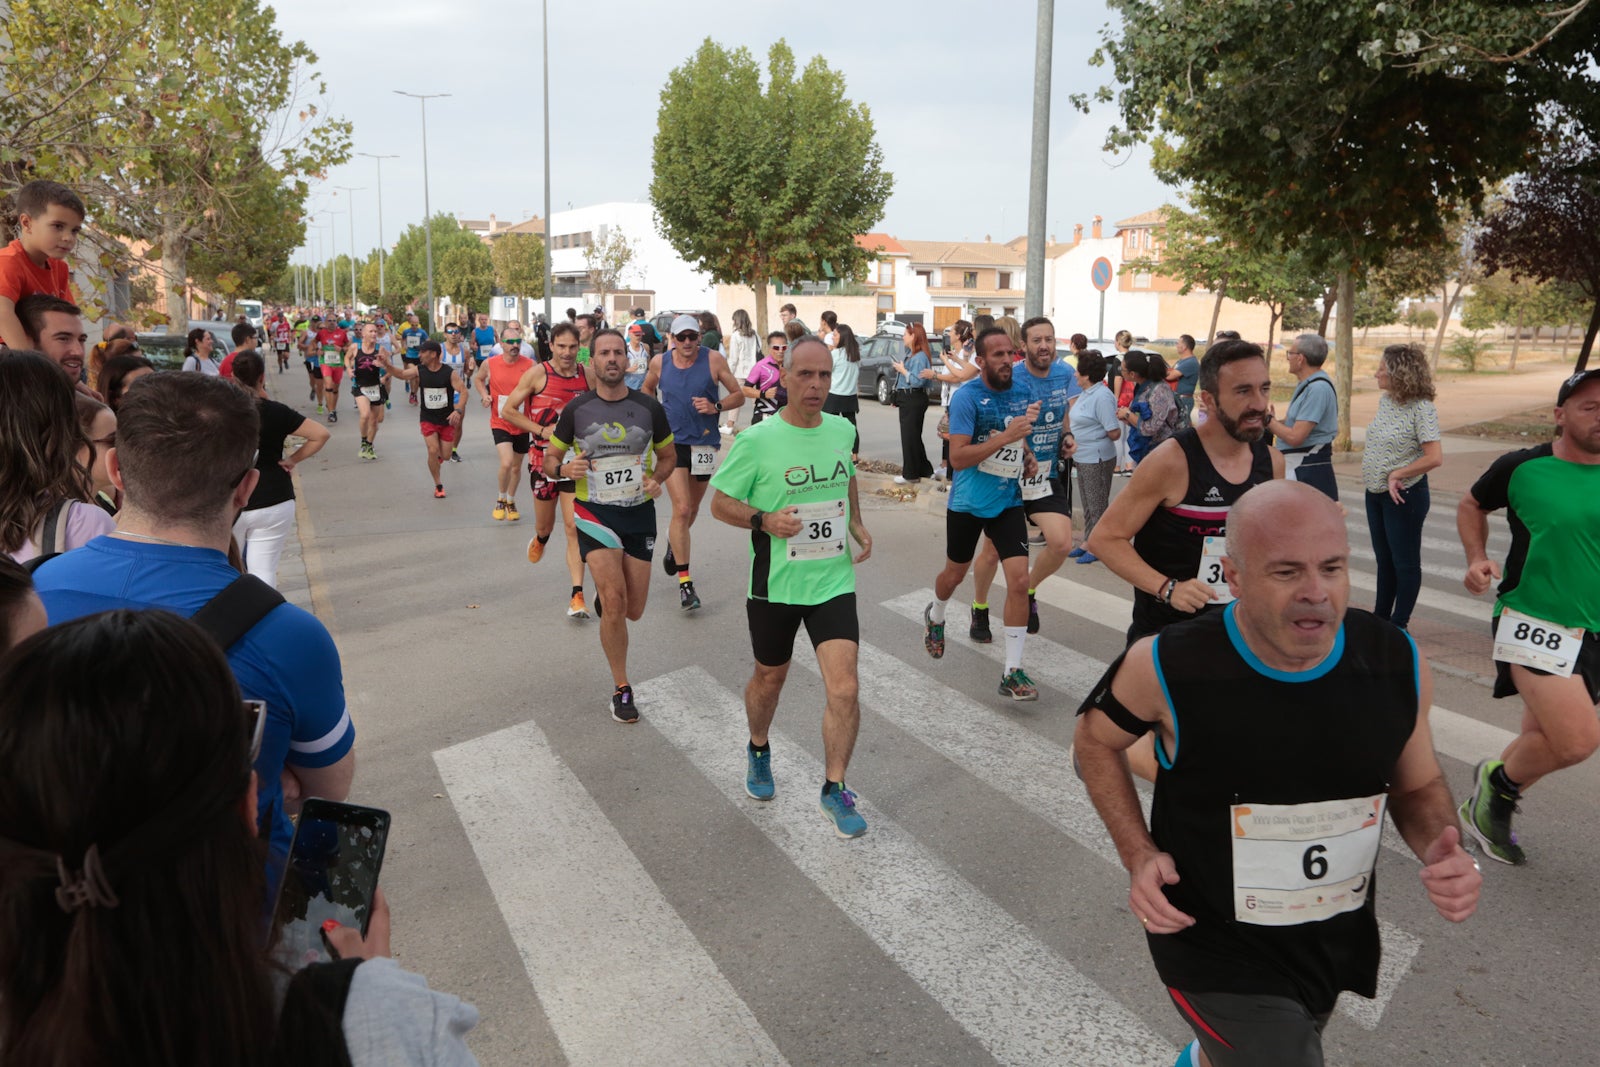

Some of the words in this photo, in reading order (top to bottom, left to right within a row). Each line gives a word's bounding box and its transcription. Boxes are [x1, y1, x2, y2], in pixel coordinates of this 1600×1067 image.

[506, 298, 514, 307] P
[429, 394, 441, 402] 597
[697, 453, 714, 464] 239
[605, 469, 633, 485] 872
[785, 460, 848, 487] OLA
[786, 488, 797, 496] DE
[798, 486, 814, 494] LOS
[808, 521, 832, 540] 36
[1514, 622, 1562, 651] 868
[1303, 845, 1328, 880] 6
